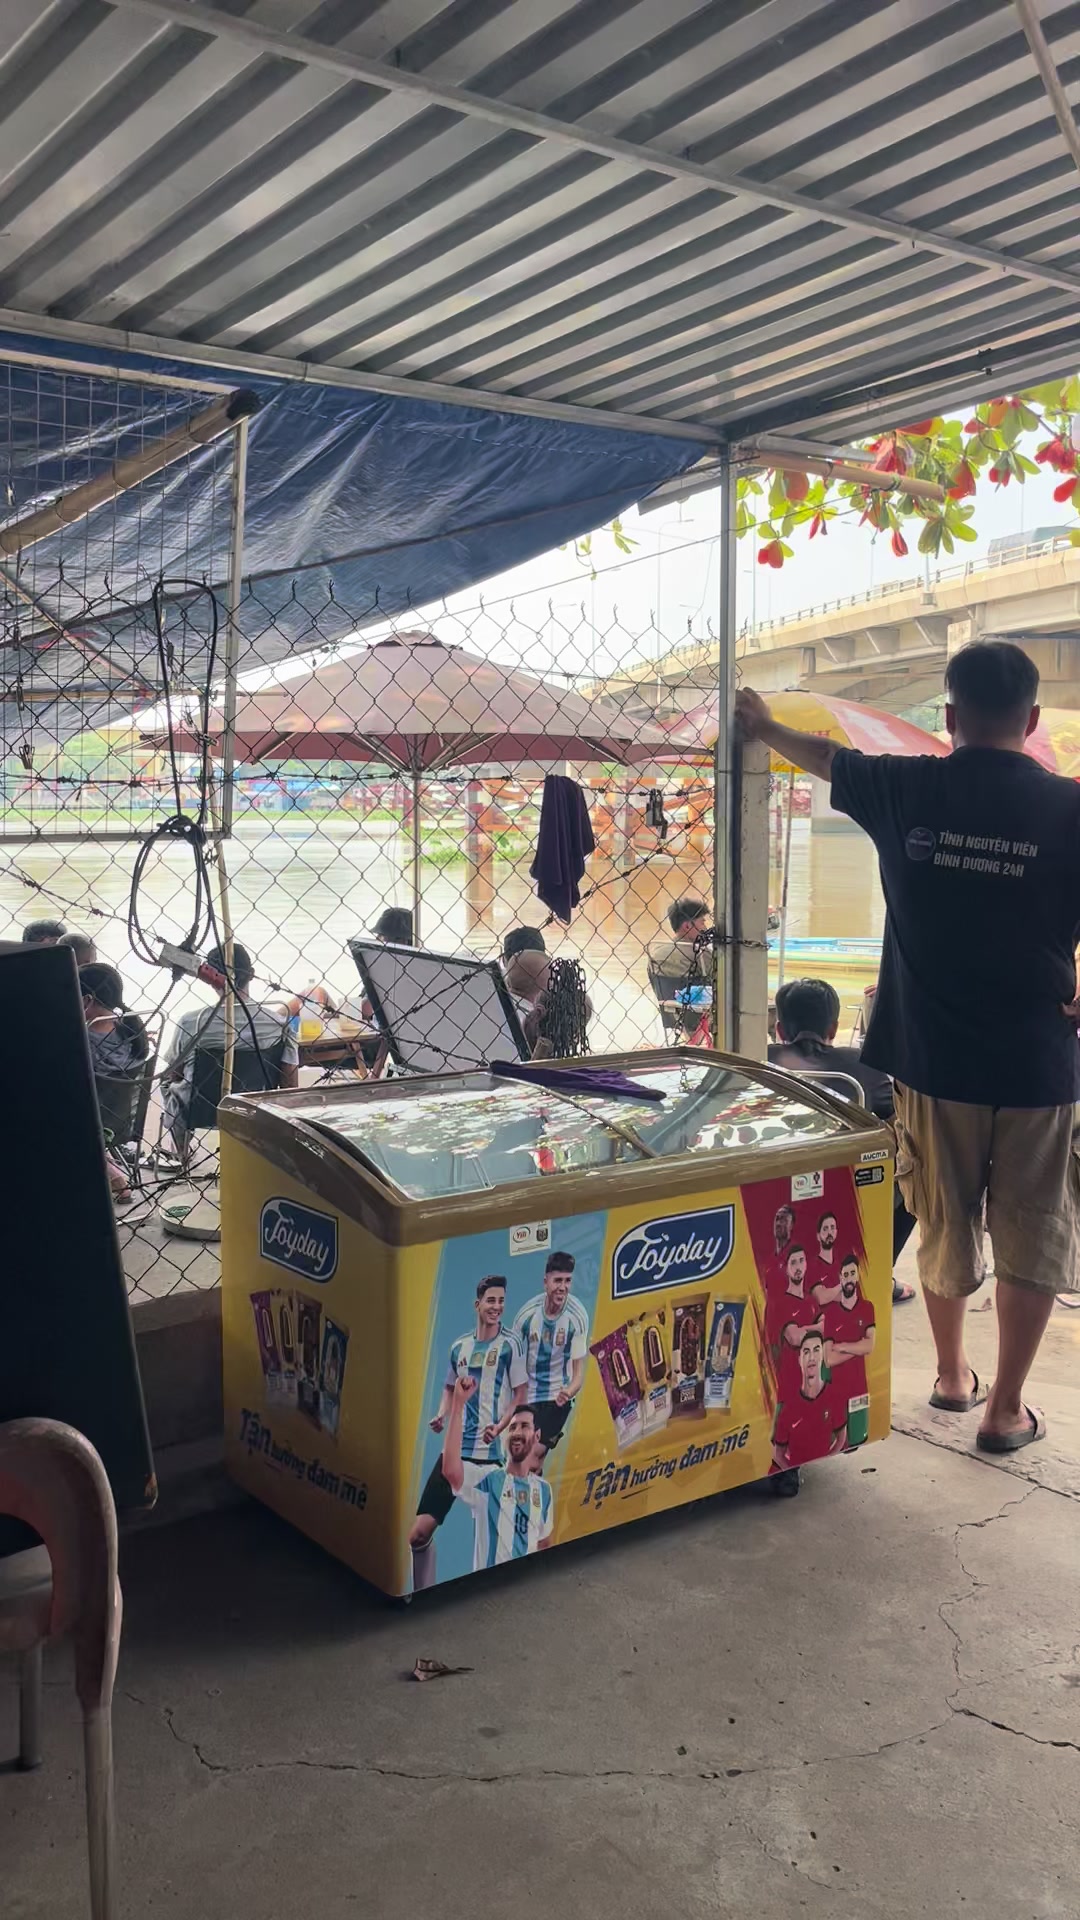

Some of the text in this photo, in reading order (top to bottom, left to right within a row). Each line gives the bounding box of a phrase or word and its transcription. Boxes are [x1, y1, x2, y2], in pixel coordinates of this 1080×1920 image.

[933, 851, 1025, 877] BÌNH DƯƠNG 24H
[966, 836, 1010, 855] NGUYỆN
[1012, 841, 1039, 857] VIÊN
[862, 1151, 887, 1161] AUCMA
[264, 1214, 330, 1273] Joyday
[619, 1231, 722, 1280] Joyday
[240, 1408, 272, 1456] Tận
[307, 1458, 339, 1494] đam
[340, 1482, 368, 1511] mê
[580, 1424, 750, 1509] Tận hưởng đam mê
